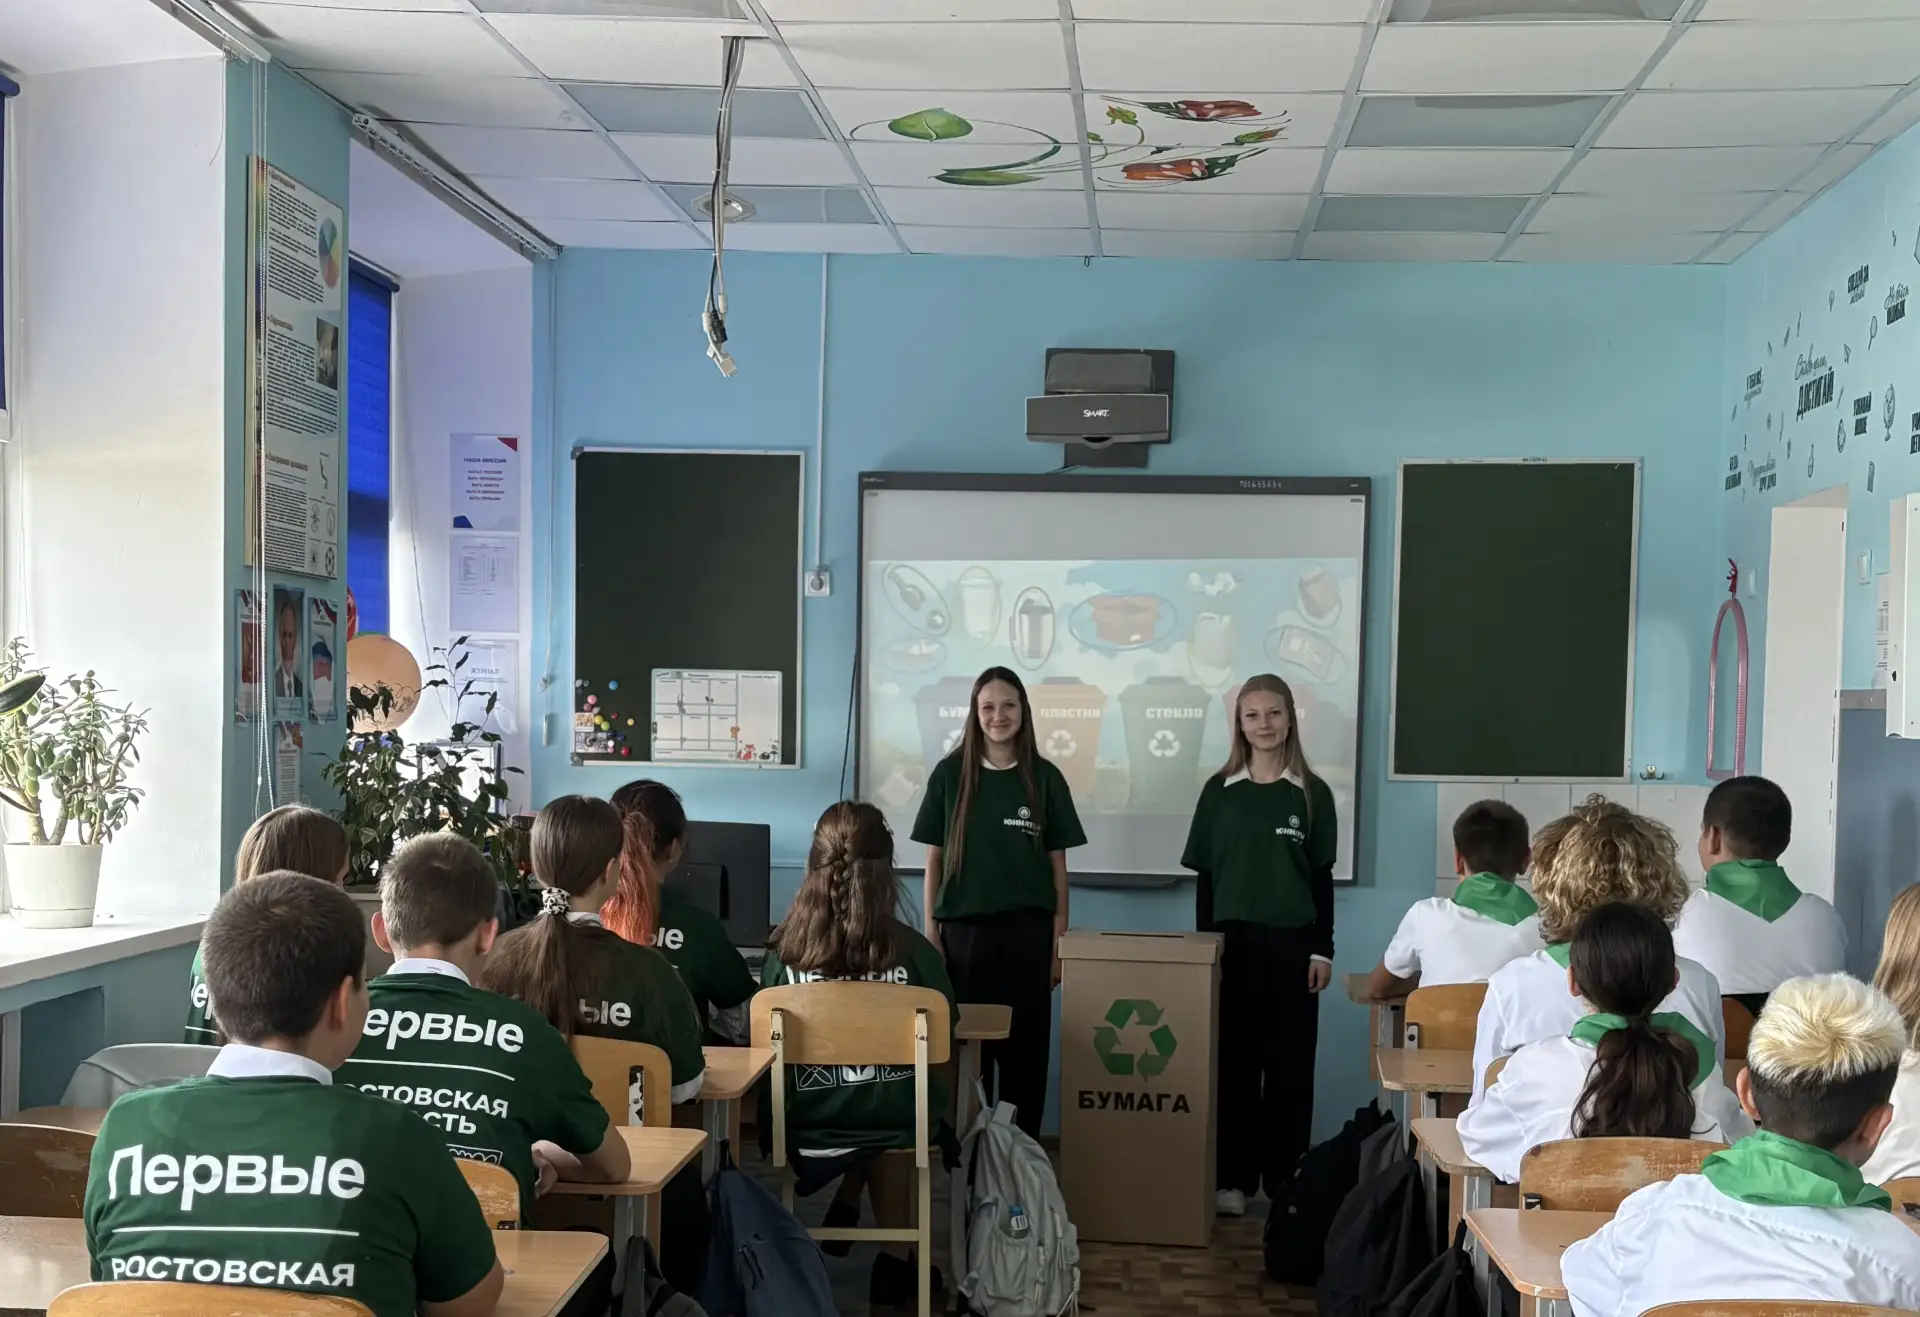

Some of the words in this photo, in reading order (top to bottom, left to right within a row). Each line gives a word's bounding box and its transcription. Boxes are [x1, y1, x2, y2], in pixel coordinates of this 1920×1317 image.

[939, 706, 970, 718] БУМ
[362, 1008, 524, 1053] ервые
[1078, 1090, 1191, 1113] БУМАГА
[108, 1143, 365, 1211] Первые
[112, 1255, 355, 1287] РОСТОВСКАЯ
